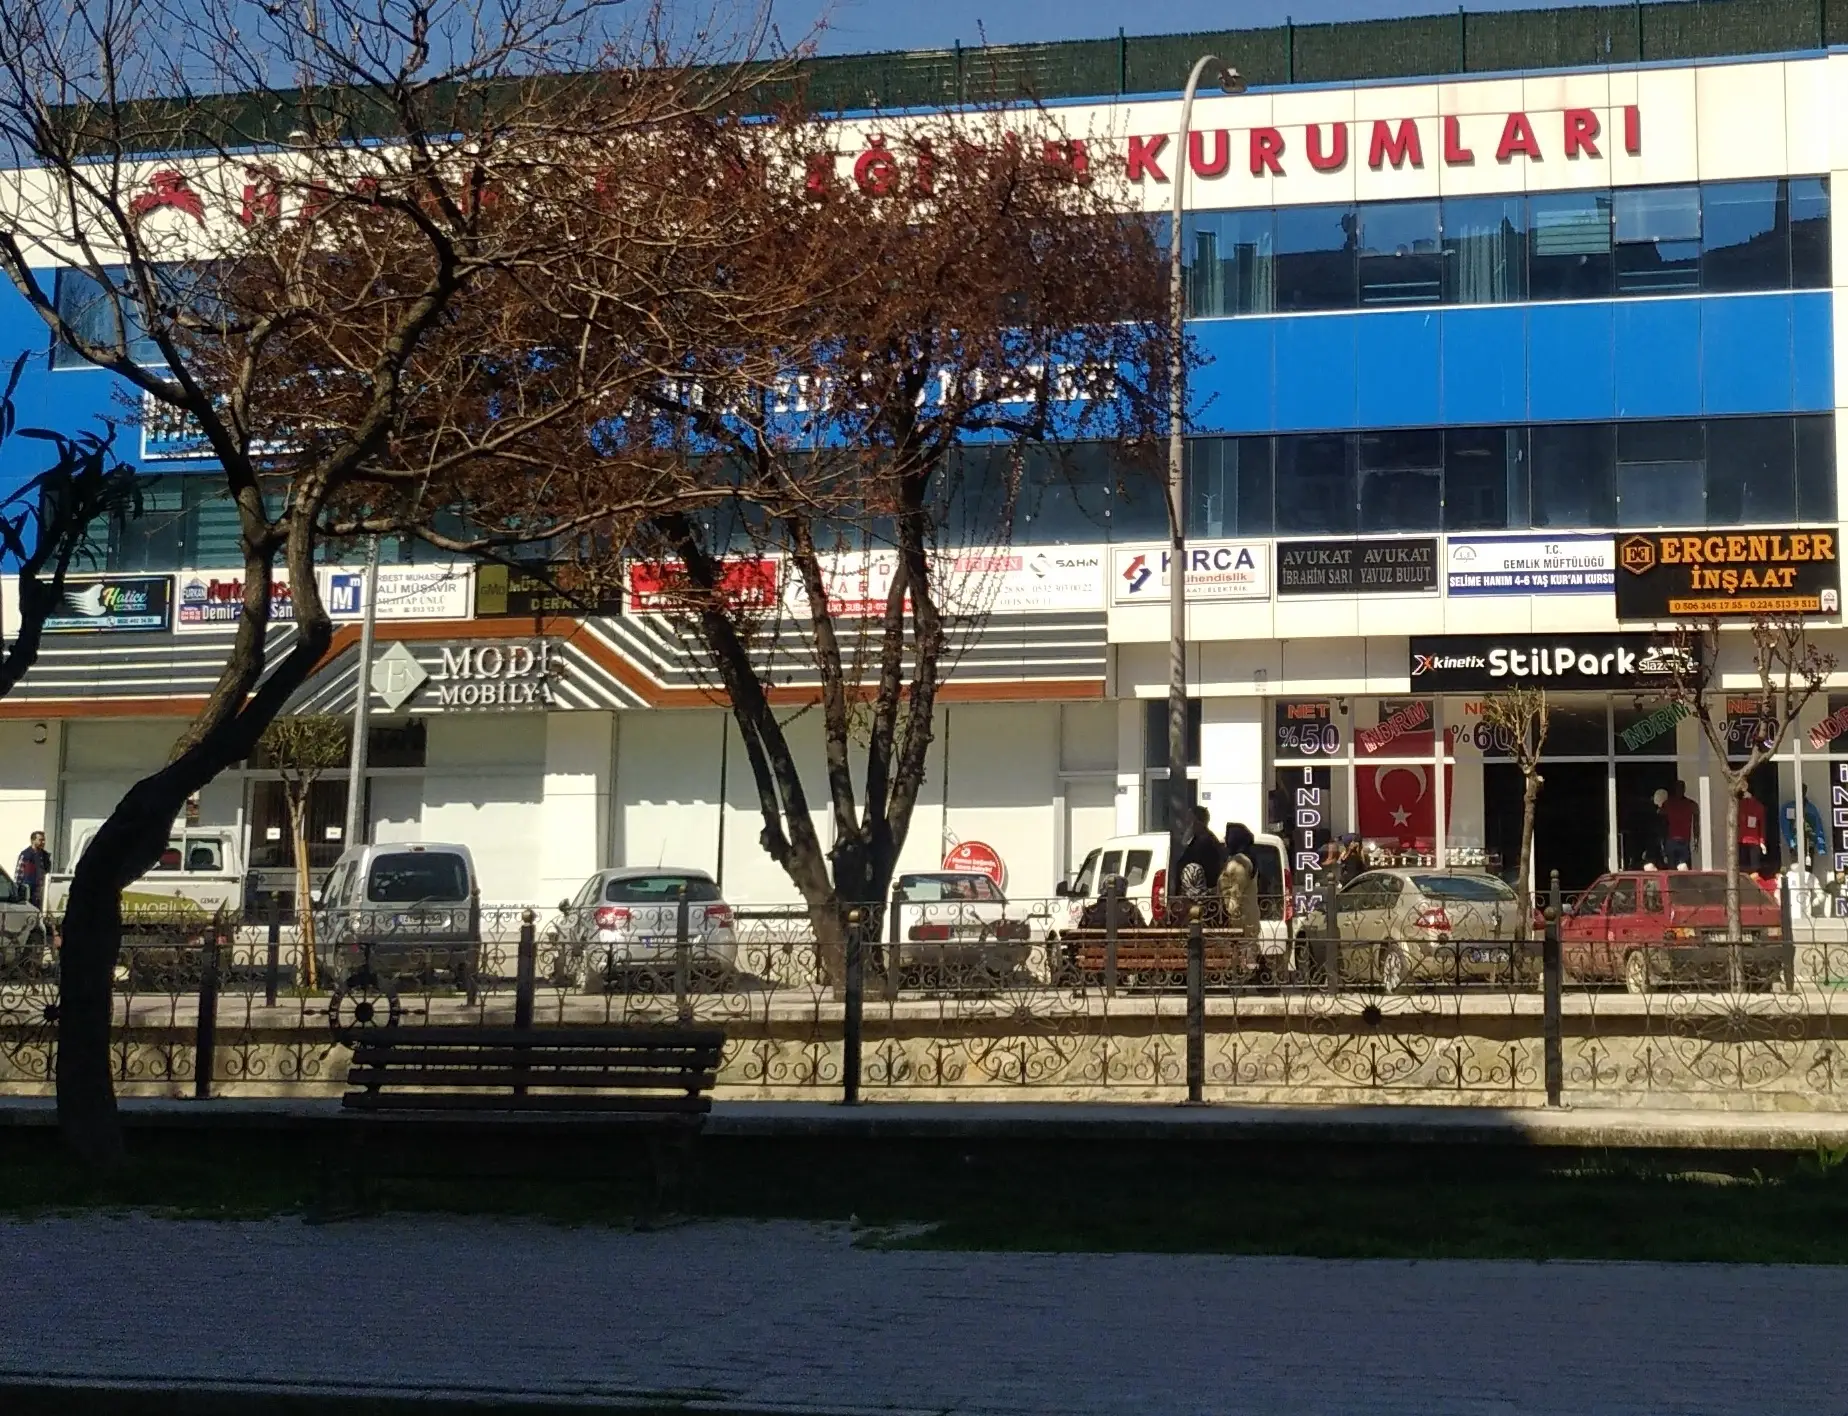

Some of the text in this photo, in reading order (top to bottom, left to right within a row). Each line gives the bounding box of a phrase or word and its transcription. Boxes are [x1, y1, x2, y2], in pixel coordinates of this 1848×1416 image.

[1126, 104, 1642, 184] KURUMLARI
[1283, 548, 1432, 565] AVUKAT AVUKAT
[1544, 544, 1563, 554] T.C.
[1659, 533, 1837, 564] ERGENLER
[1161, 547, 1256, 573] KIRCA
[1543, 555, 1605, 568] MÜFTÜLÜĞÜ
[376, 574, 403, 582] RBEST
[1184, 574, 1249, 583] hendislik
[1283, 566, 1432, 585] İBRAHİM SARI YAVUZ BULUT
[1449, 571, 1615, 588] SELİME HANIM 4-6 YAŞ KUR'AN KURSU
[1690, 564, 1797, 594] İNŞAAT
[103, 586, 148, 606] Hatice
[376, 581, 457, 594] ALİ MÜŞAVİR
[271, 602, 293, 618] San
[1720, 601, 1729, 609] 17
[1776, 600, 1791, 608] 513
[1801, 600, 1817, 608] 513
[441, 640, 549, 678] MODİ
[1433, 647, 1636, 677] kinetix StilPark
[1639, 660, 1700, 674] Slaze
[438, 681, 554, 705] MOBİLYA
[1287, 703, 1330, 719] NET
[1279, 723, 1341, 754] %50
[1451, 721, 1515, 751] %60
